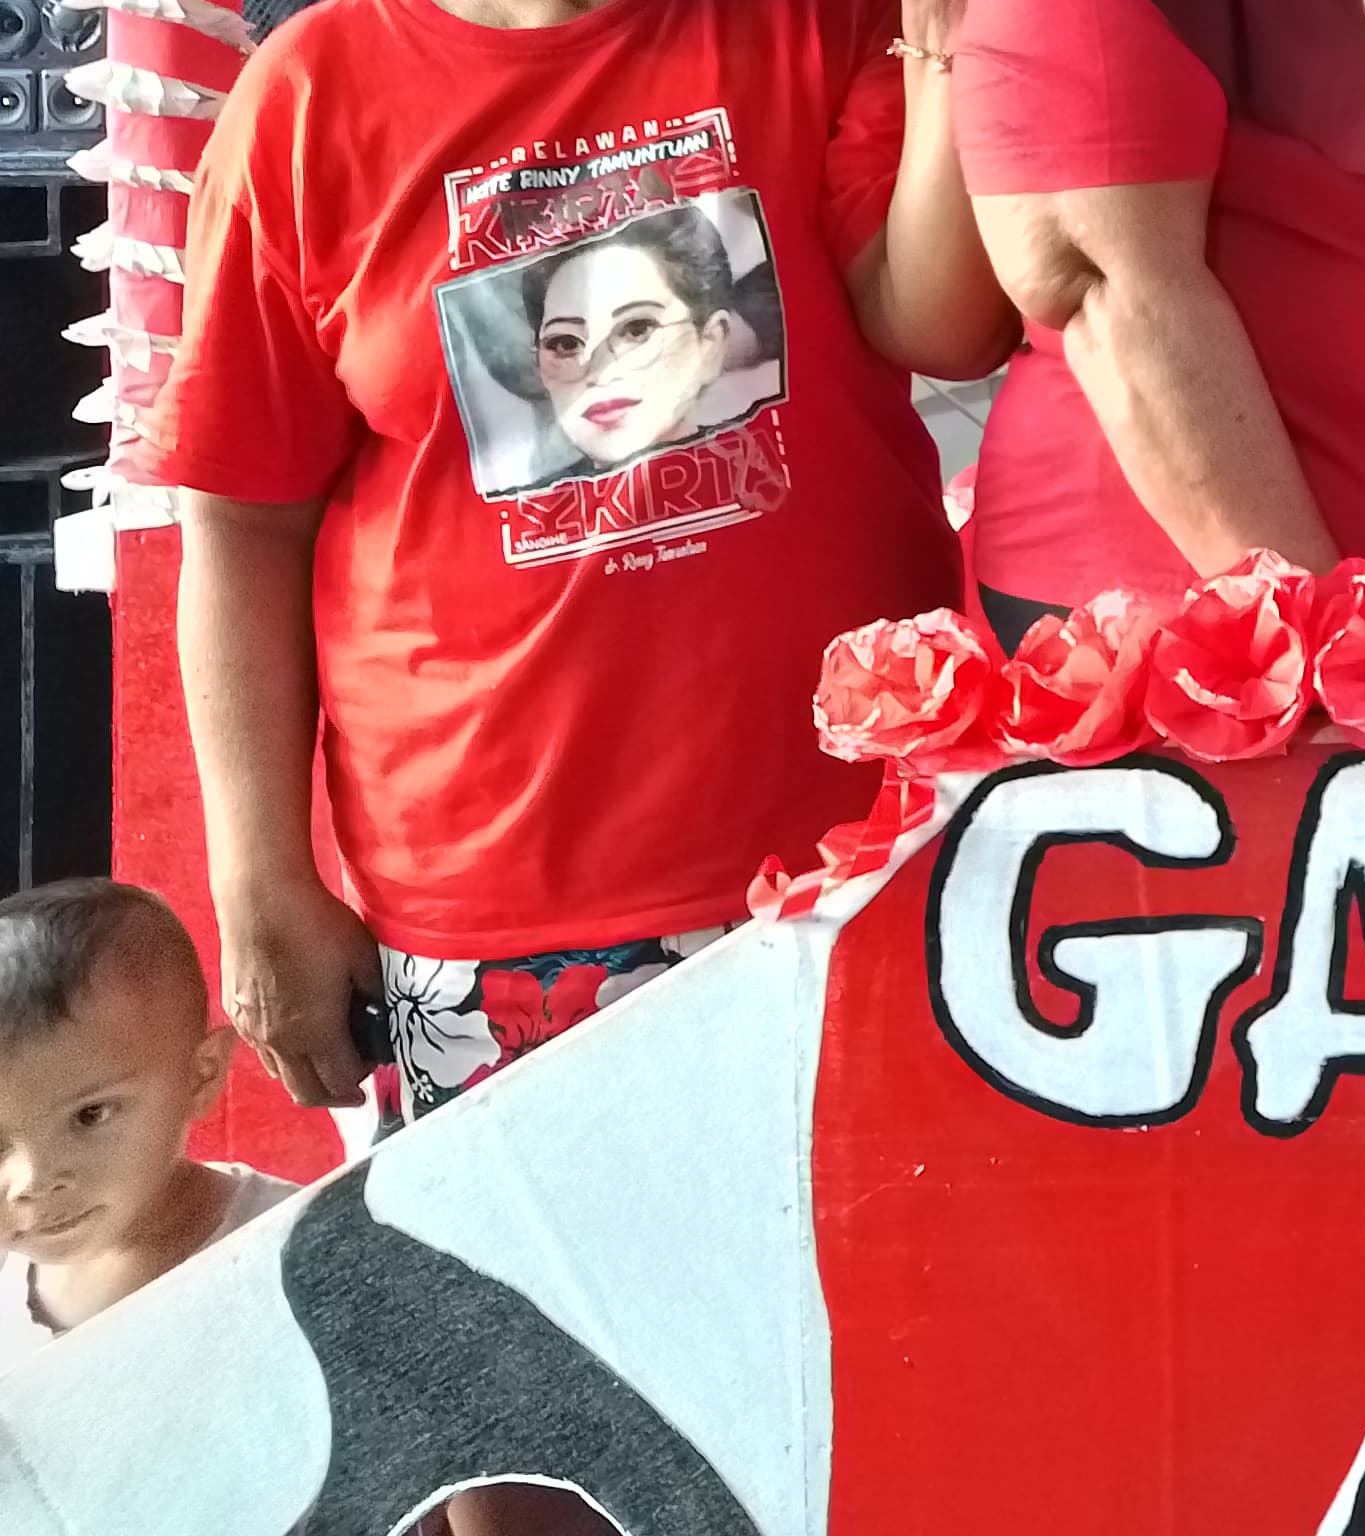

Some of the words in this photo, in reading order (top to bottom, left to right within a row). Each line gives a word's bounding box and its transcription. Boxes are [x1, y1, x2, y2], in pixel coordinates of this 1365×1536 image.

[511, 119, 659, 164] RELAWAN
[519, 165, 580, 190] RINNY
[587, 130, 709, 179] TAMUNTUAN
